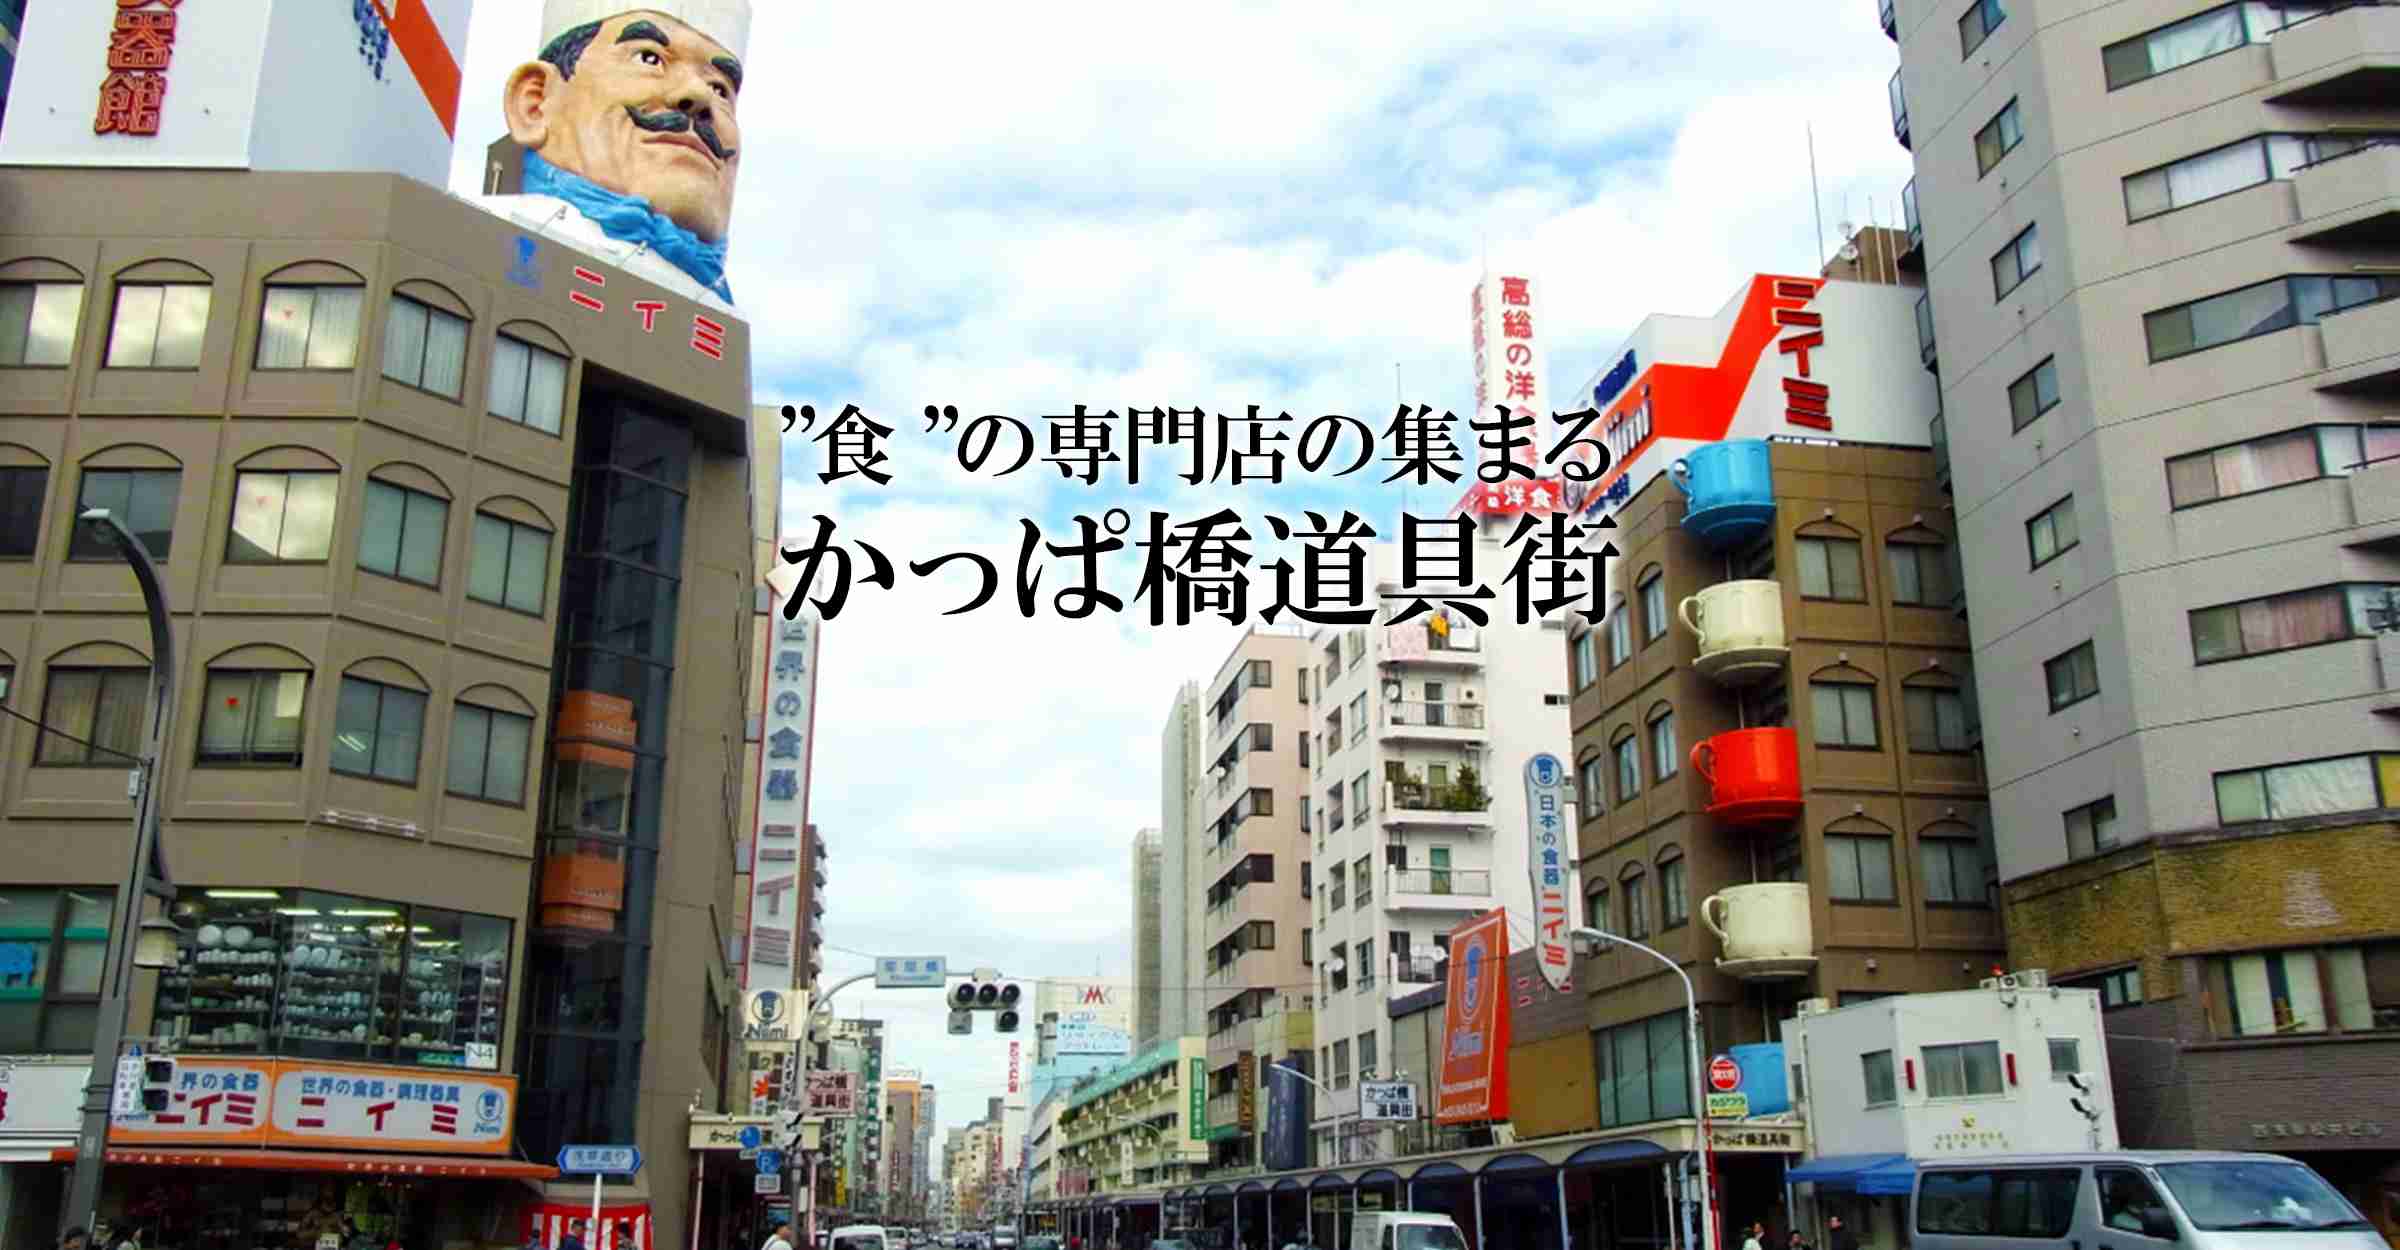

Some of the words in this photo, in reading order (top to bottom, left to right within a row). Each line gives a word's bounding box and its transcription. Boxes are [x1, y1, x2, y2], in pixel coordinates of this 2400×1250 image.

[95, 0, 183, 135] 器館
[569, 266, 724, 360] ニイミ
[1776, 282, 1832, 432] ニイミ
[154, 1093, 257, 1126] ニイミ
[297, 1096, 459, 1136] ニイミ
